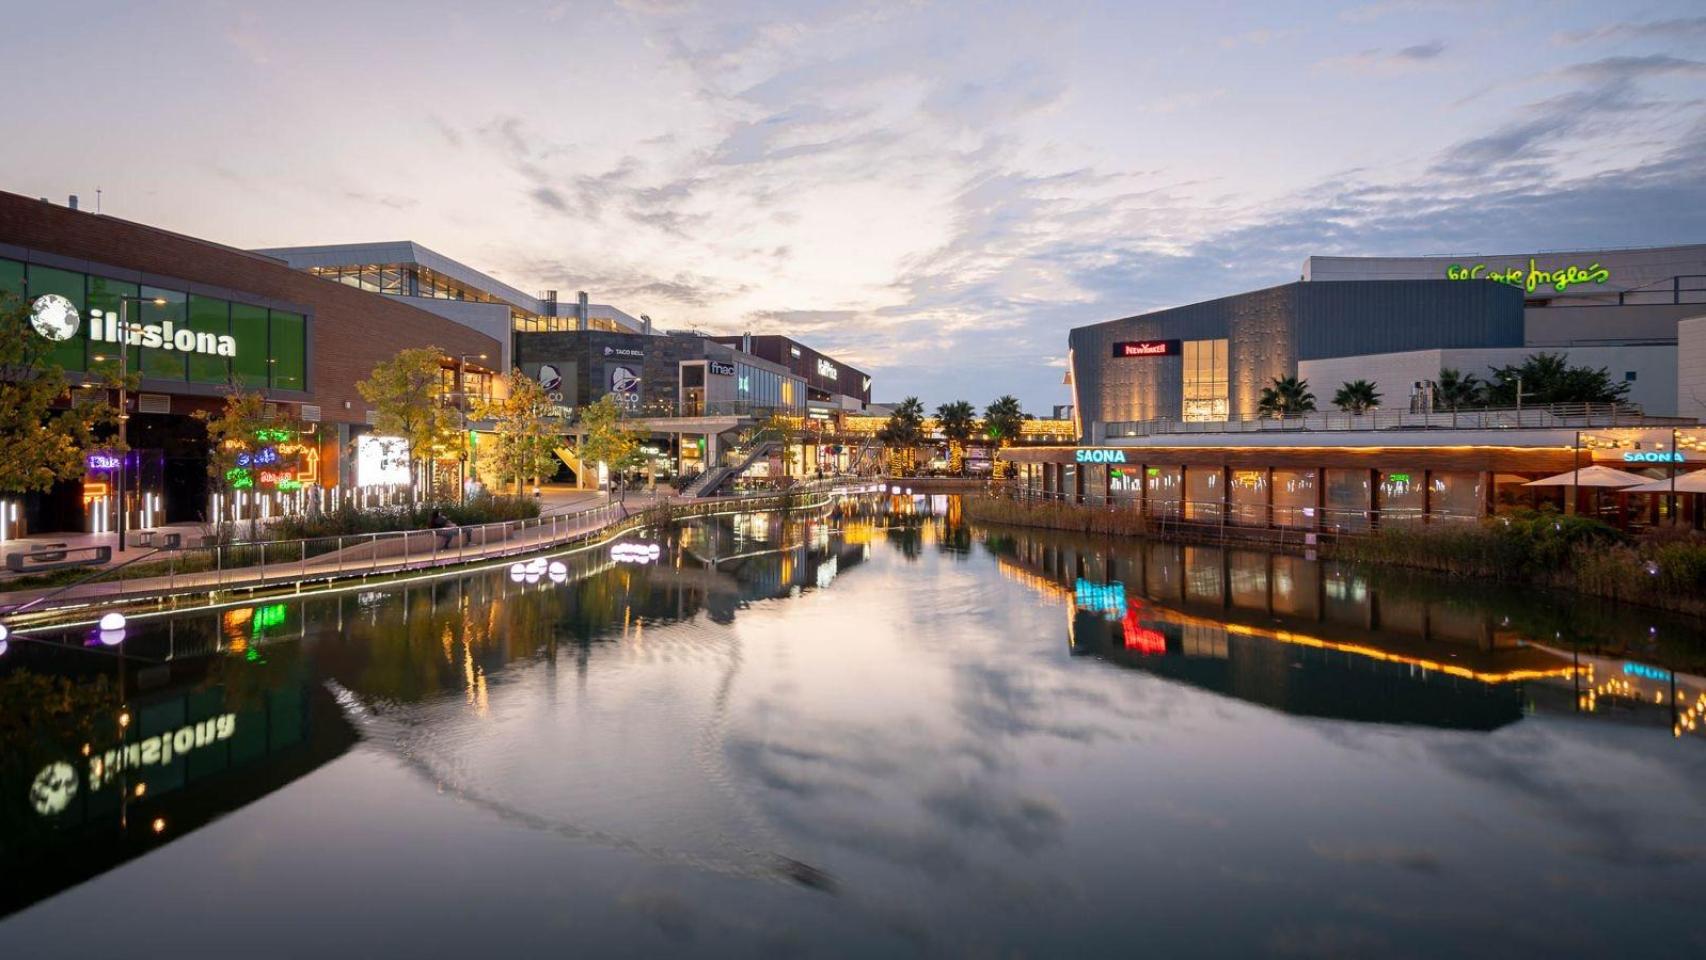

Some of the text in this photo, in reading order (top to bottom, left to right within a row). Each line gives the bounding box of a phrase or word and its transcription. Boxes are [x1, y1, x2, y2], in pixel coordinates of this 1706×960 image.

[1526, 258, 1609, 292] Inglés
[711, 361, 736, 375] fnac
[1076, 450, 1126, 463] SAONA
[1623, 452, 1684, 462] SAONA
